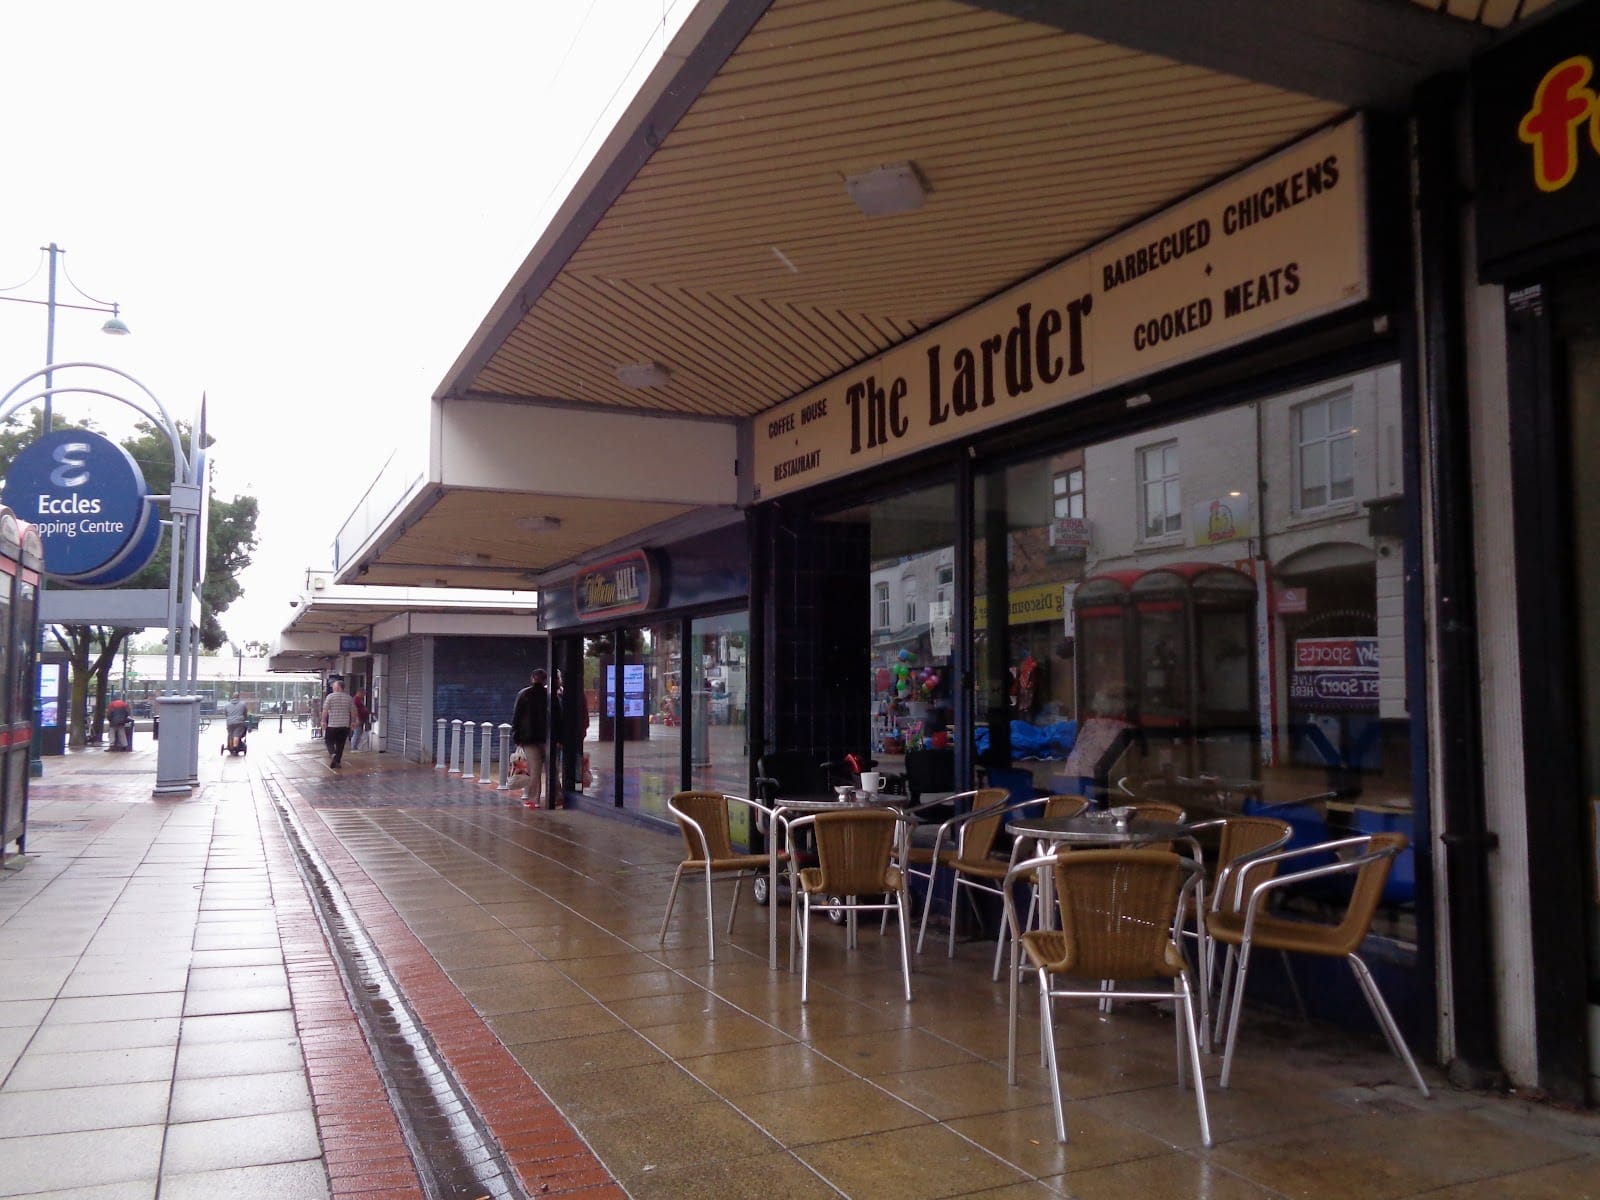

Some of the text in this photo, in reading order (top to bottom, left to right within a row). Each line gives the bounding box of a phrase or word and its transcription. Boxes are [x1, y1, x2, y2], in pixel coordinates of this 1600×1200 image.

[1518, 55, 1600, 192] f
[1103, 155, 1339, 292] BARBECUED CHICKENS
[1134, 262, 1301, 352] COOKED MEATS
[845, 293, 1093, 455] The Larder
[768, 398, 828, 439] COFFEE HOUSE
[773, 448, 822, 482] RESTAURANT
[38, 493, 101, 514] Eccles
[80, 519, 124, 533] Centre
[615, 566, 639, 601] HILL
